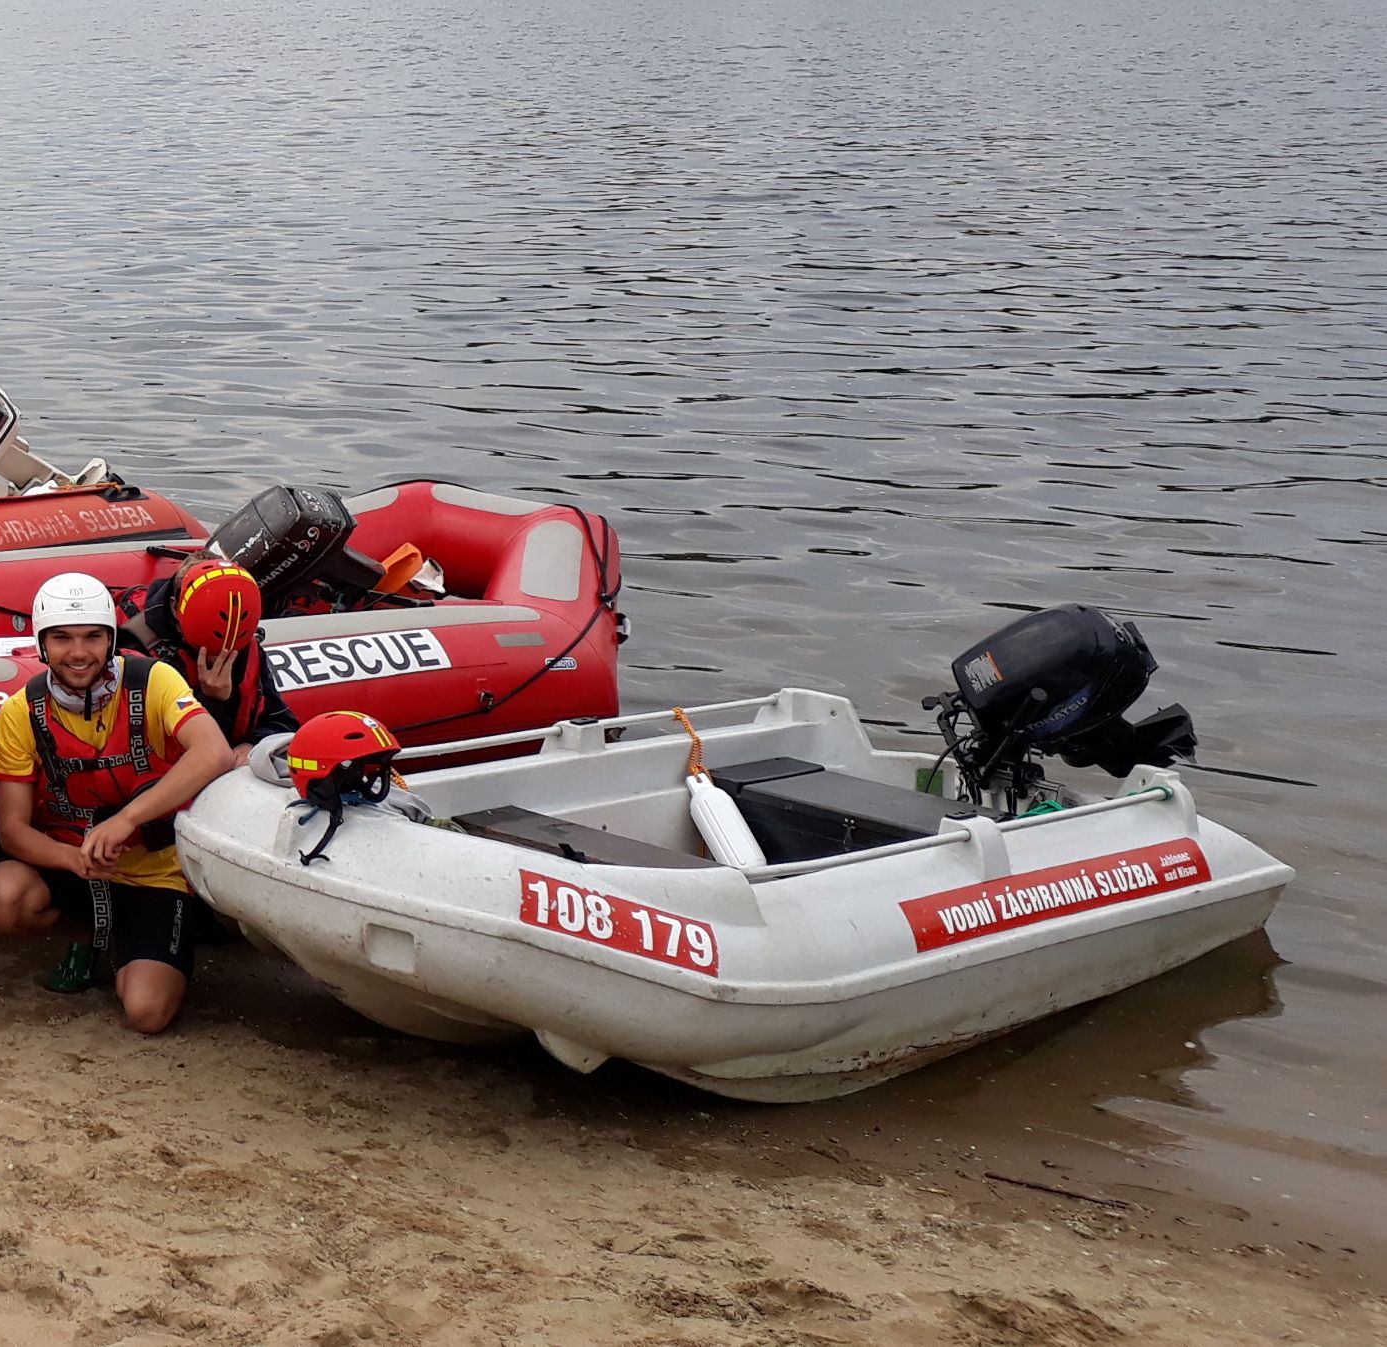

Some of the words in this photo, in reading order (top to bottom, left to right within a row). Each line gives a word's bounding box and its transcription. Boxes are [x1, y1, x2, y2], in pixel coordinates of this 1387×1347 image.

[79, 503, 154, 533] SLUŽBA
[266, 632, 441, 688] RESCUE
[528, 880, 613, 940] 108
[631, 909, 713, 967] 179
[938, 891, 997, 935] VODNÍ
[996, 868, 1099, 921] ZÁCHRANNÁ
[1095, 859, 1159, 897] SLUŽBA
